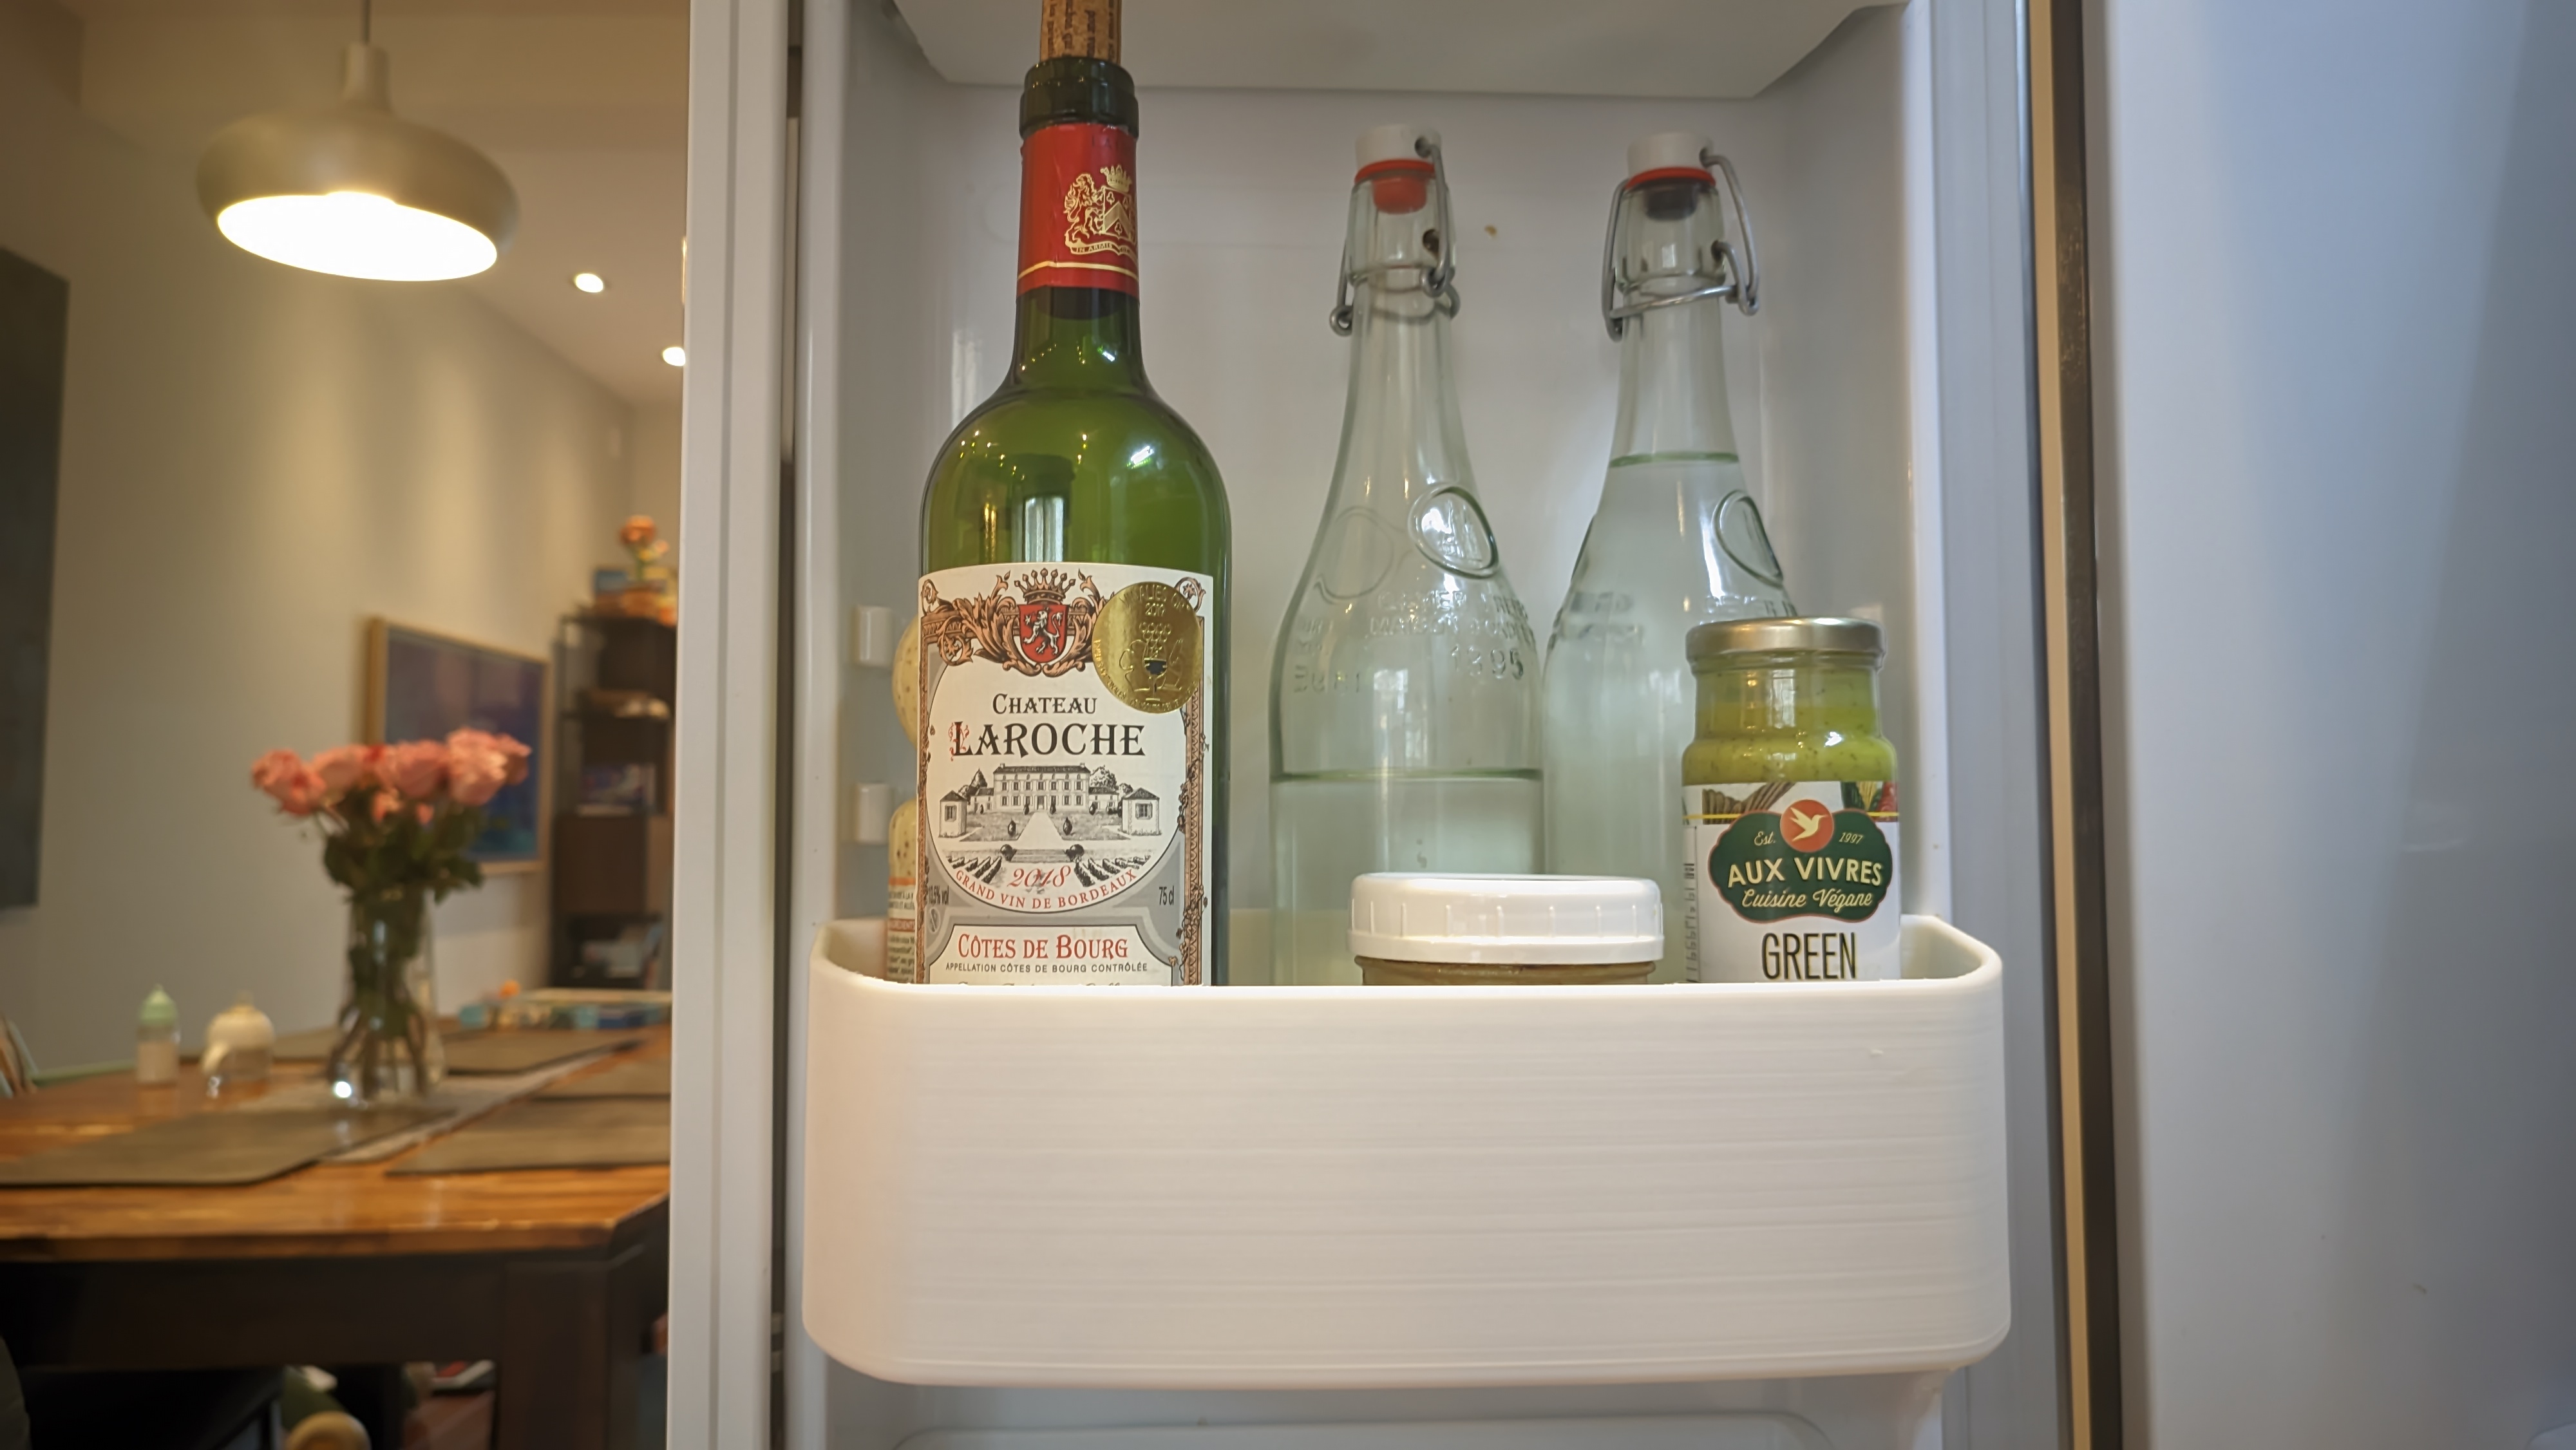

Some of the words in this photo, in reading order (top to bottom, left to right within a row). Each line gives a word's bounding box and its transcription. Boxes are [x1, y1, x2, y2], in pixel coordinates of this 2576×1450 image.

[992, 693, 1097, 715] CHATEAU
[952, 721, 1146, 758] LAROCHE
[1754, 831, 1776, 847] Est.
[1839, 831, 1863, 845] 1997
[1007, 865, 1072, 888] 2018
[1727, 858, 1786, 888] AUX
[1793, 856, 1882, 887] VIVRES
[956, 869, 995, 900] GRAND
[1000, 893, 1025, 909] VIN
[1032, 898, 1052, 909] DE
[1058, 869, 1137, 908] BORDEAUX
[1159, 886, 1167, 905] 75
[1168, 885, 1175, 905] cl
[1741, 888, 1807, 908] Cuisine
[1812, 888, 1873, 913] Végane
[958, 933, 1017, 959] CÔTES
[1023, 939, 1049, 959] DE
[1056, 934, 1128, 961] BOURG
[1761, 932, 1856, 980] GREEN
[945, 962, 996, 972] APPELLATION
[1000, 962, 1031, 973] CÔTES
[1035, 965, 1047, 973] DE
[1052, 964, 1087, 973] BOURG
[1091, 961, 1148, 972] CONTRÔLÉE
